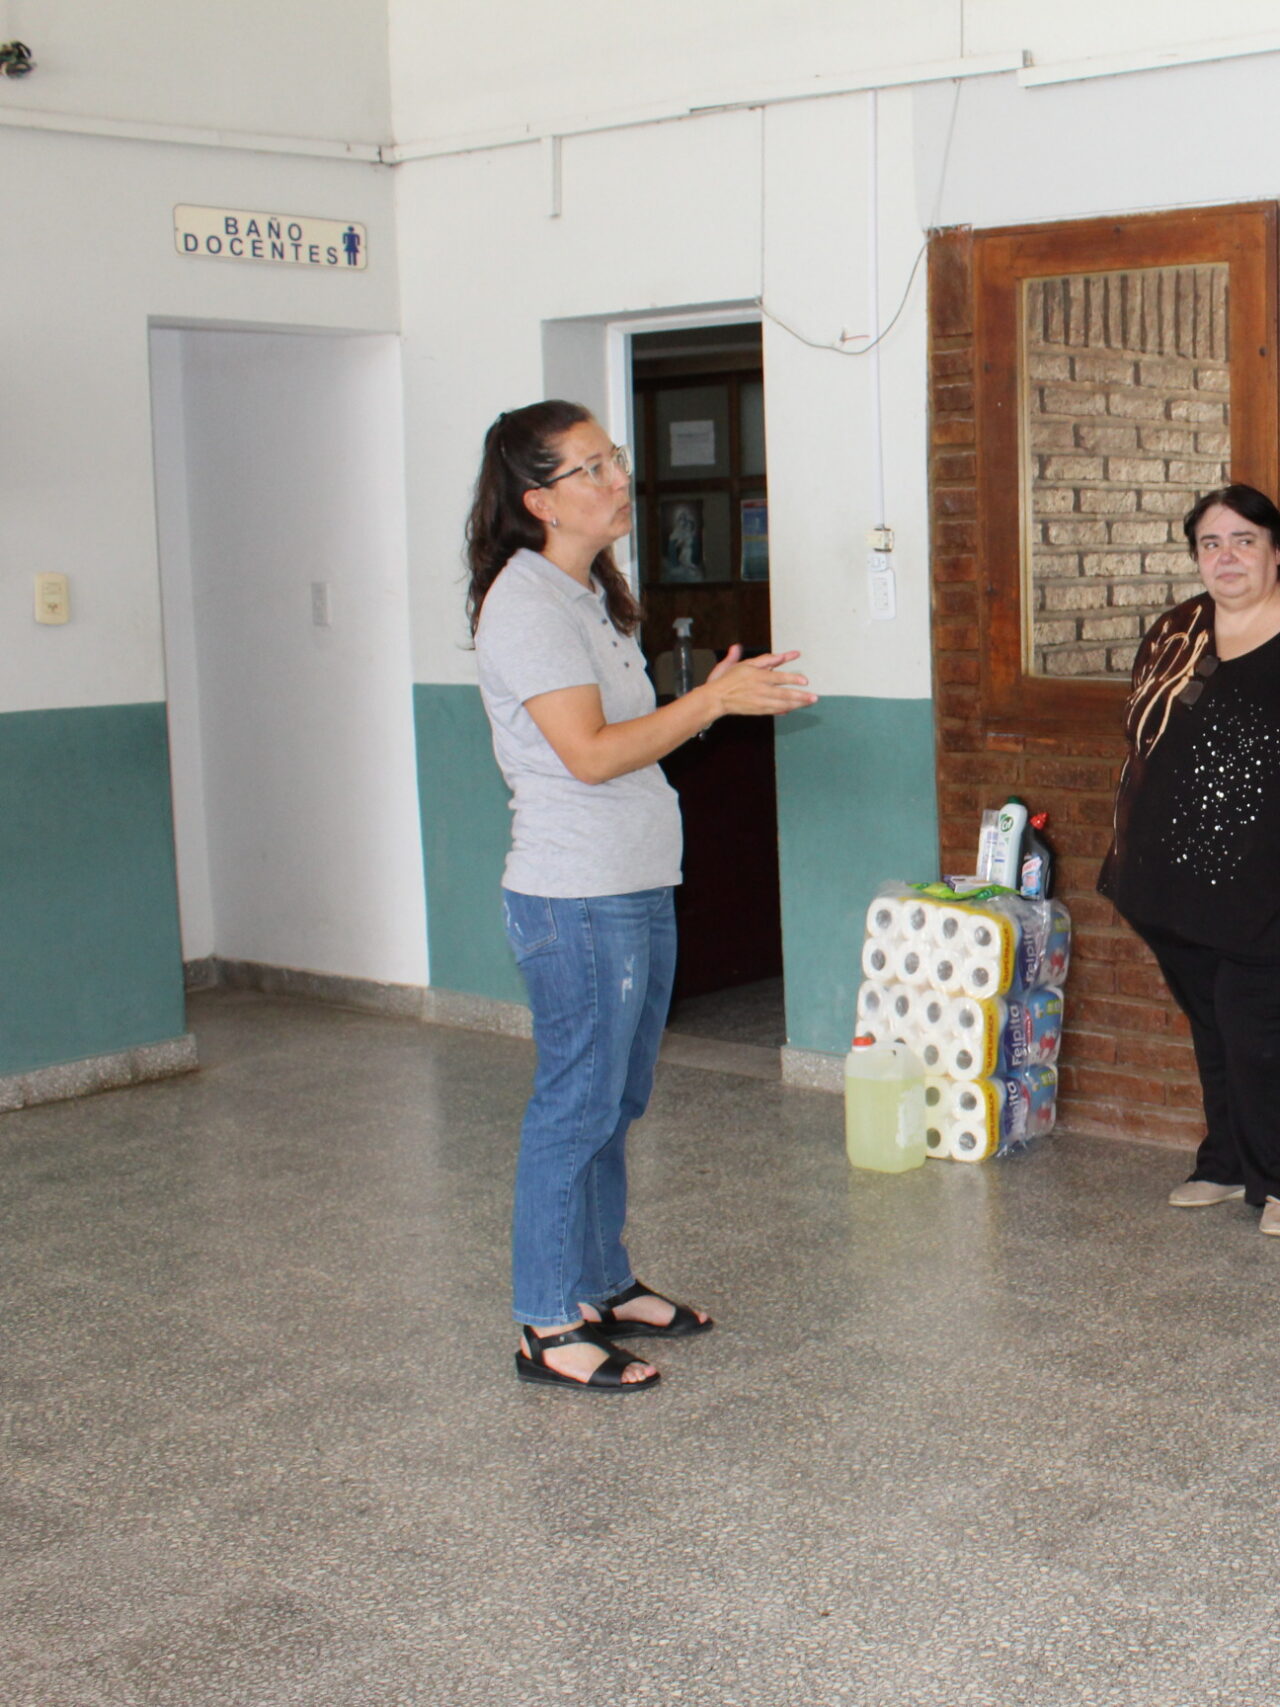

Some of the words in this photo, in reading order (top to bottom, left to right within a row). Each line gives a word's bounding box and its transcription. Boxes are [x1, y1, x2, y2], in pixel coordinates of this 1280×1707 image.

[225, 216, 302, 241] BAÑO
[183, 233, 338, 265] DOCENTES
[1010, 1005, 1025, 1067] Felpita
